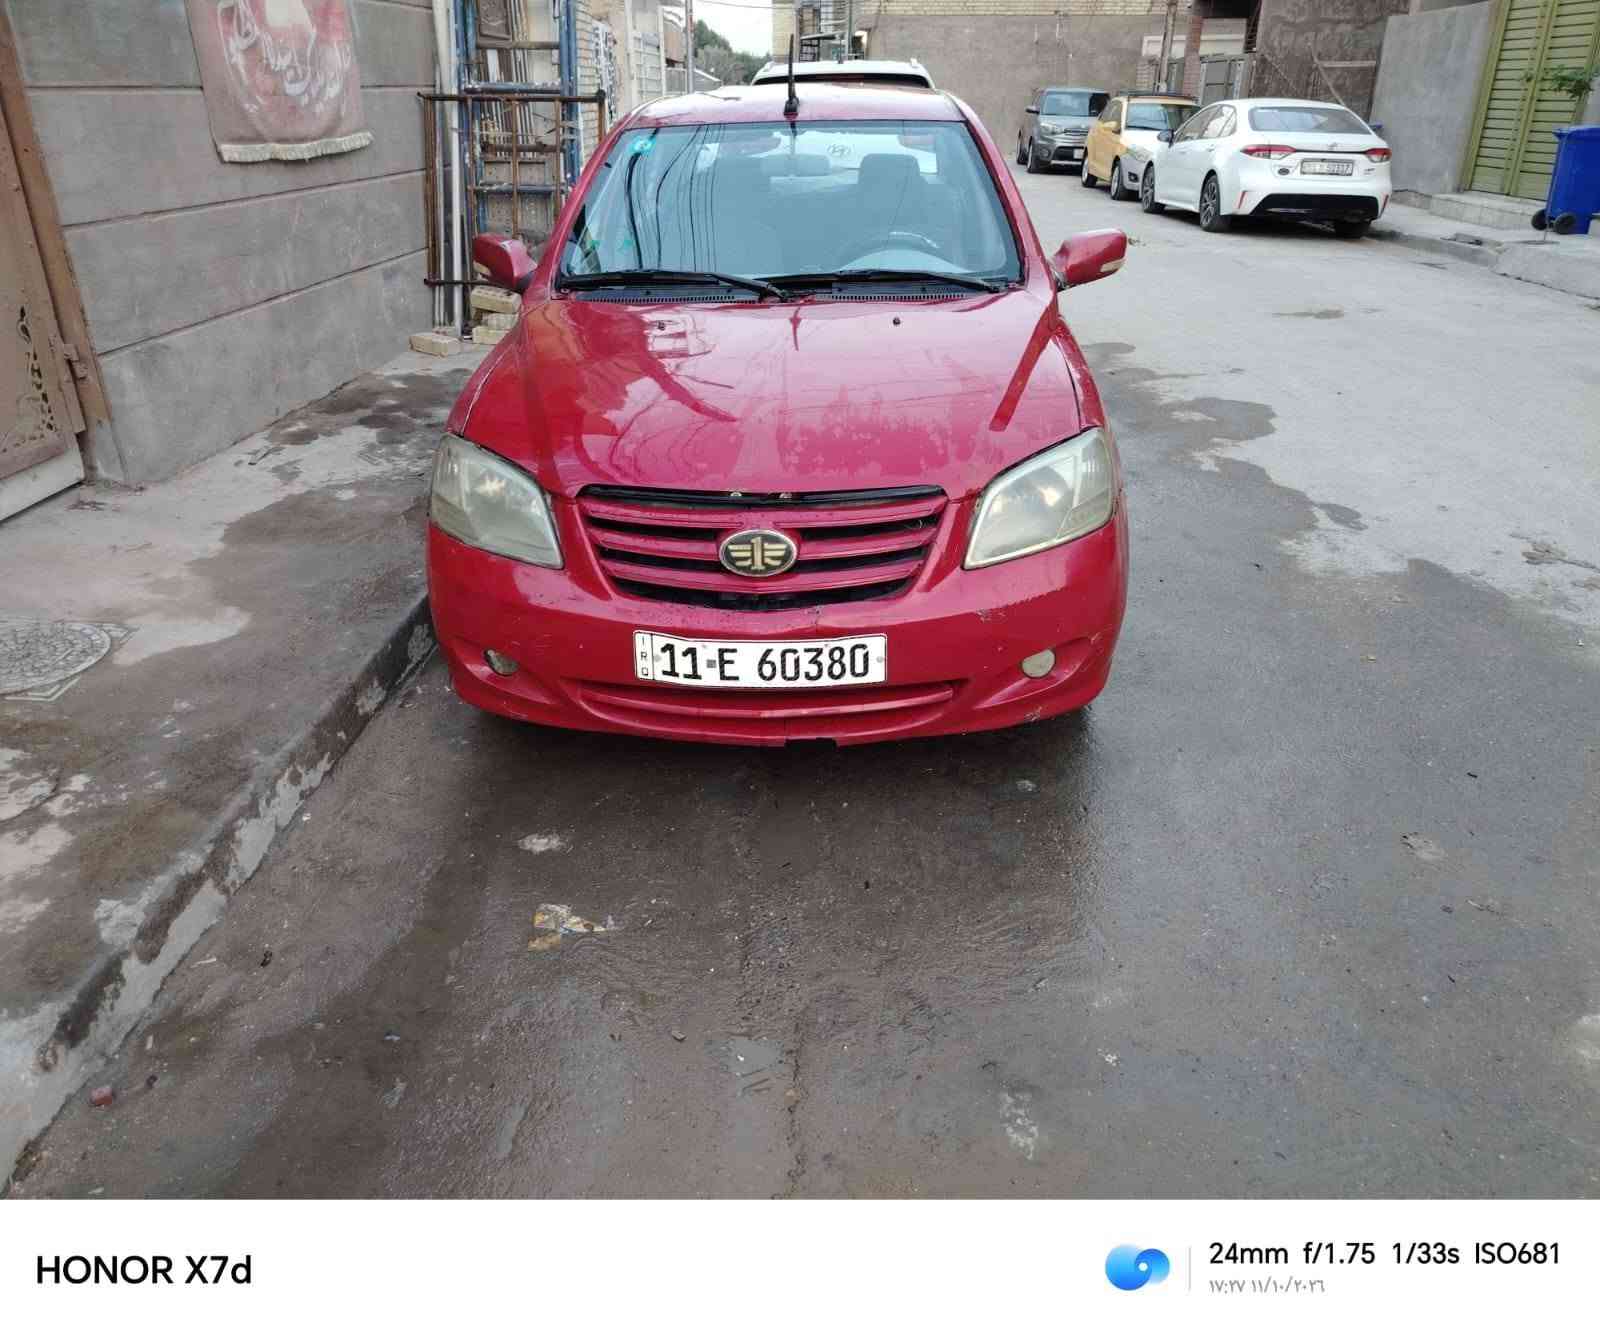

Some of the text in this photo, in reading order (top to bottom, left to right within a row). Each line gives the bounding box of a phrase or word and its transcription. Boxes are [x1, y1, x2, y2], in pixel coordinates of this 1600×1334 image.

[660, 643, 870, 682] 11 E 60380
